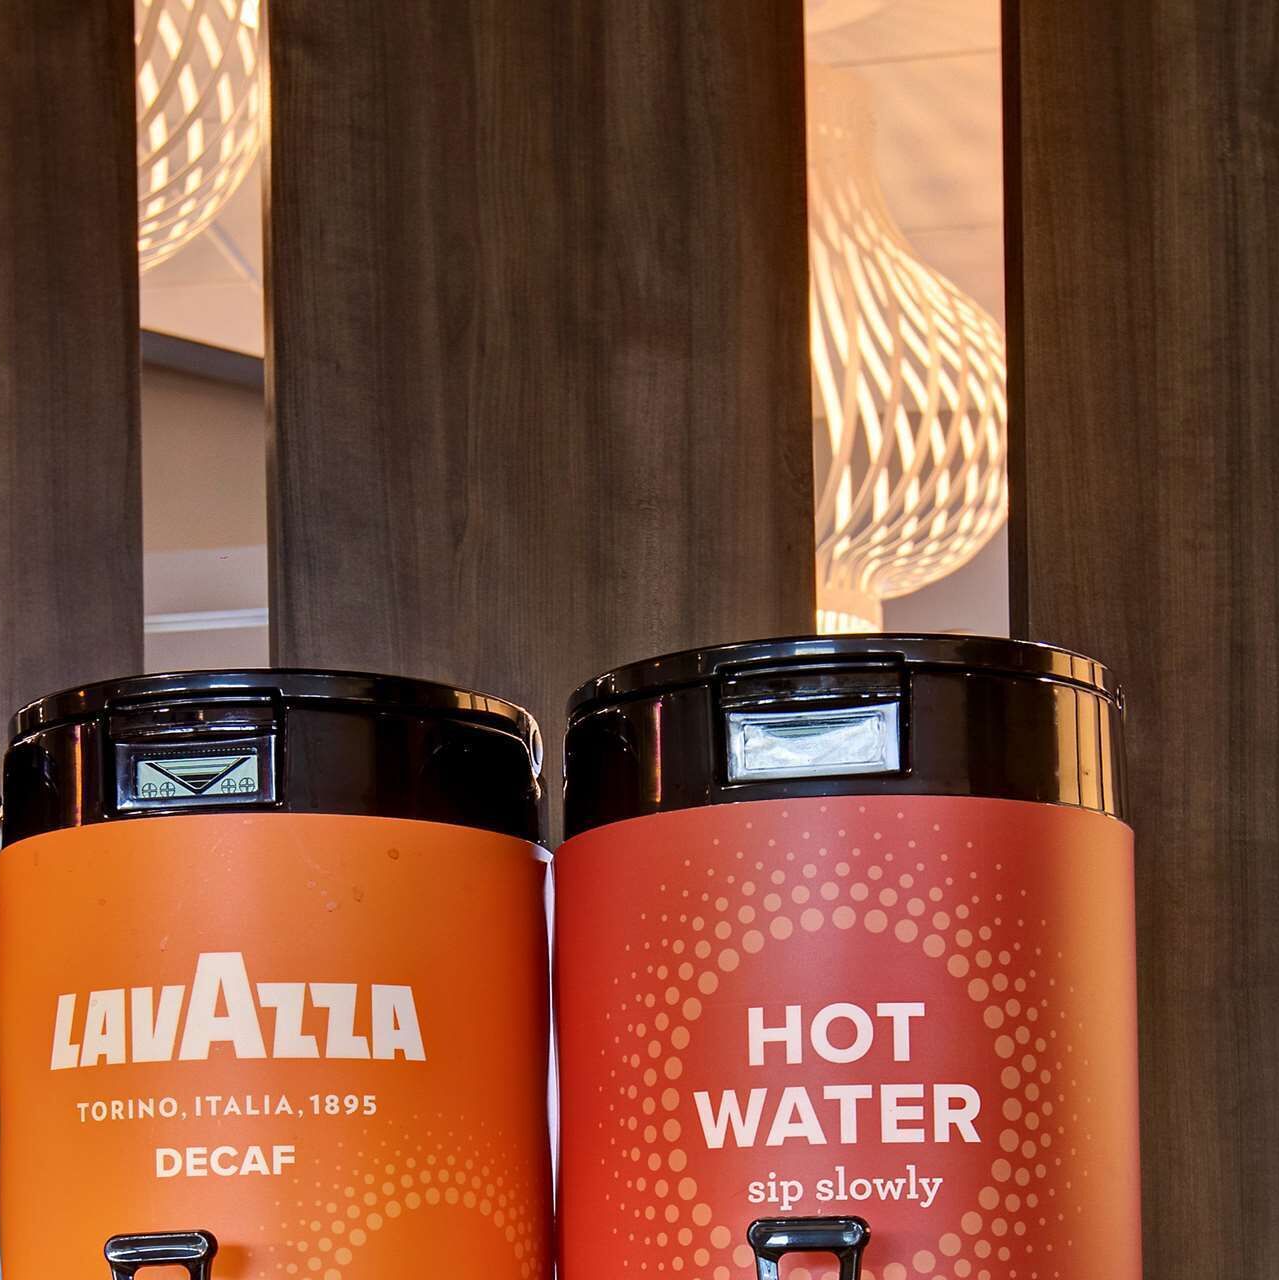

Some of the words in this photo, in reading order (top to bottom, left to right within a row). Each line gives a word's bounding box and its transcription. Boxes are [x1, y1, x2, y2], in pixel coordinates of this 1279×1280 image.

[50, 952, 426, 1070] LAVAZZA
[747, 1002, 925, 1066] HOT
[77, 1096, 186, 1123] TORINO,
[195, 1095, 304, 1117] ITALIA,
[309, 1094, 377, 1116] 1895
[693, 1083, 982, 1149] WATER
[156, 1145, 295, 1178] DECAF
[747, 1171, 803, 1210] sip
[815, 1165, 943, 1208] slowly
